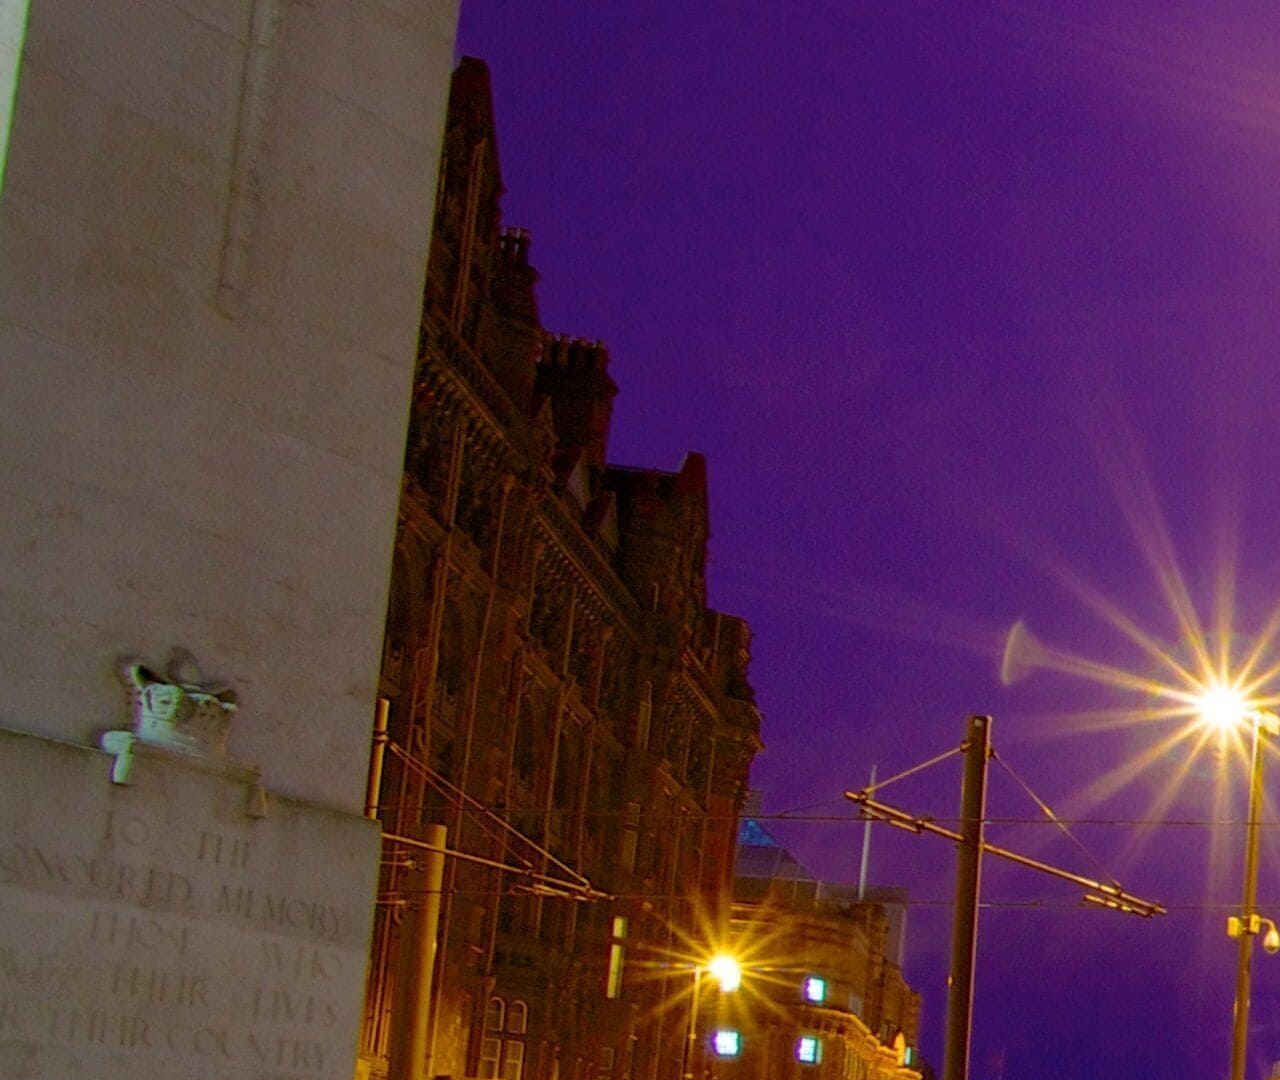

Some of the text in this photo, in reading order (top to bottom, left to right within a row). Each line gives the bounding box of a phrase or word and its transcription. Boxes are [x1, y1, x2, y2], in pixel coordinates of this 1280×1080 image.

[103, 810, 255, 869] TO THE
[217, 884, 343, 938] MEMORY
[111, 964, 208, 1006] THEIR
[48, 1008, 152, 1049] THEIR
[167, 1024, 331, 1072] COUNTRY
